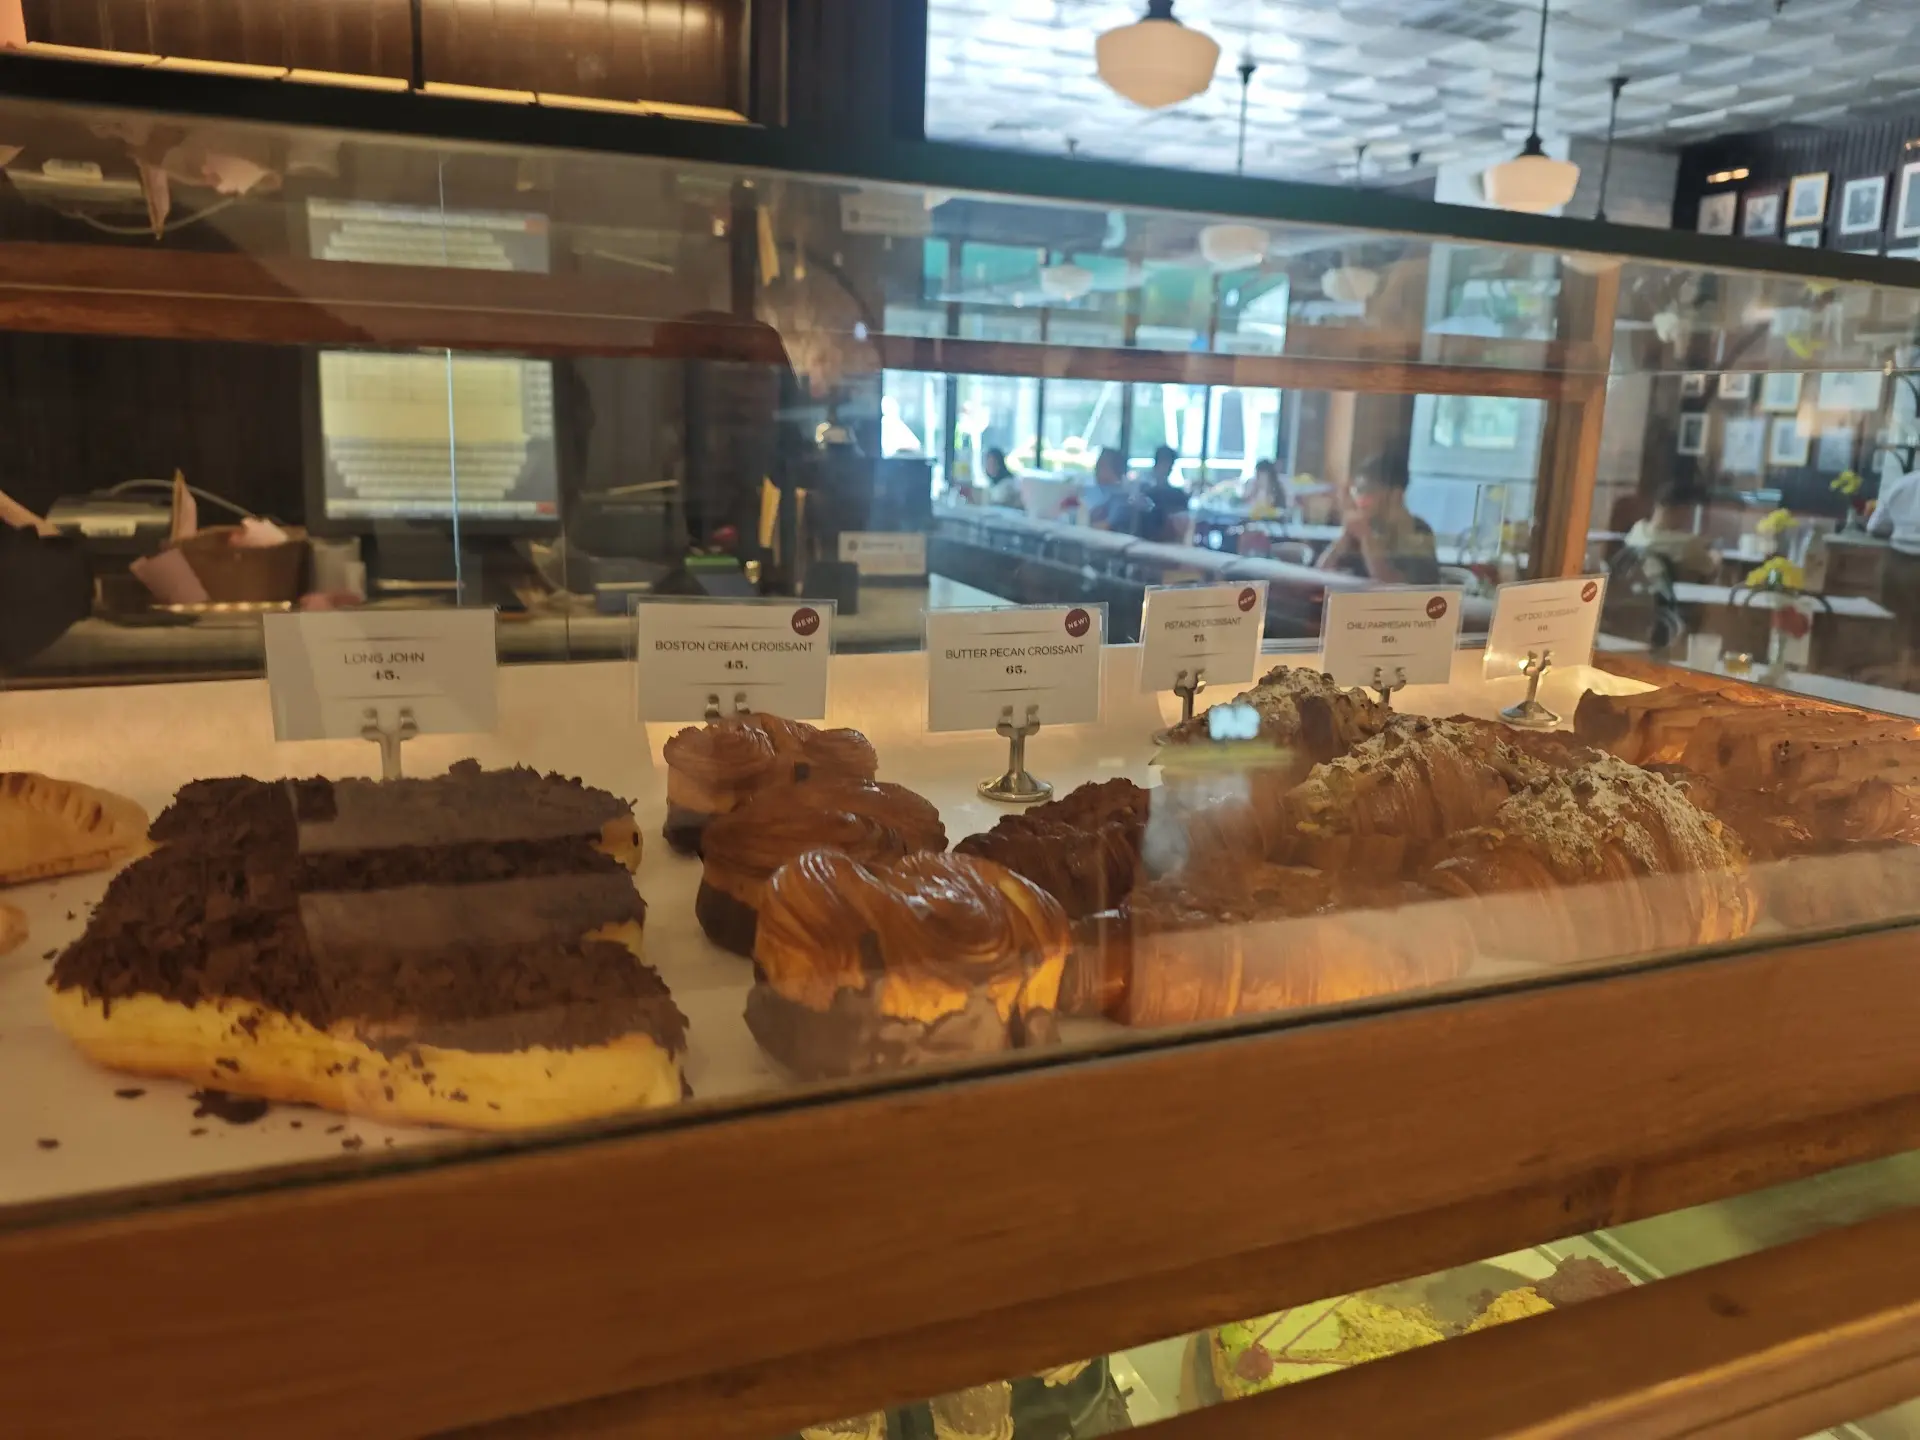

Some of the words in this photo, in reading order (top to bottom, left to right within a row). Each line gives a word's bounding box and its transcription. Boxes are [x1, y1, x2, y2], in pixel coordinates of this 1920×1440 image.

[795, 615, 818, 629] NEW!
[1067, 617, 1088, 630] NEW!
[1367, 620, 1411, 630] PARMESAN
[655, 640, 705, 652] BOSTON
[707, 641, 749, 652] CREAM
[751, 641, 814, 653] CROISSANT
[945, 648, 988, 660] BUTTER
[989, 647, 1026, 658] PECAN
[1027, 644, 1085, 656] CROISSANT
[344, 652, 384, 665] LONG
[387, 651, 425, 664] JOHN
[724, 660, 749, 670] 45.
[1005, 665, 1028, 675] 65.
